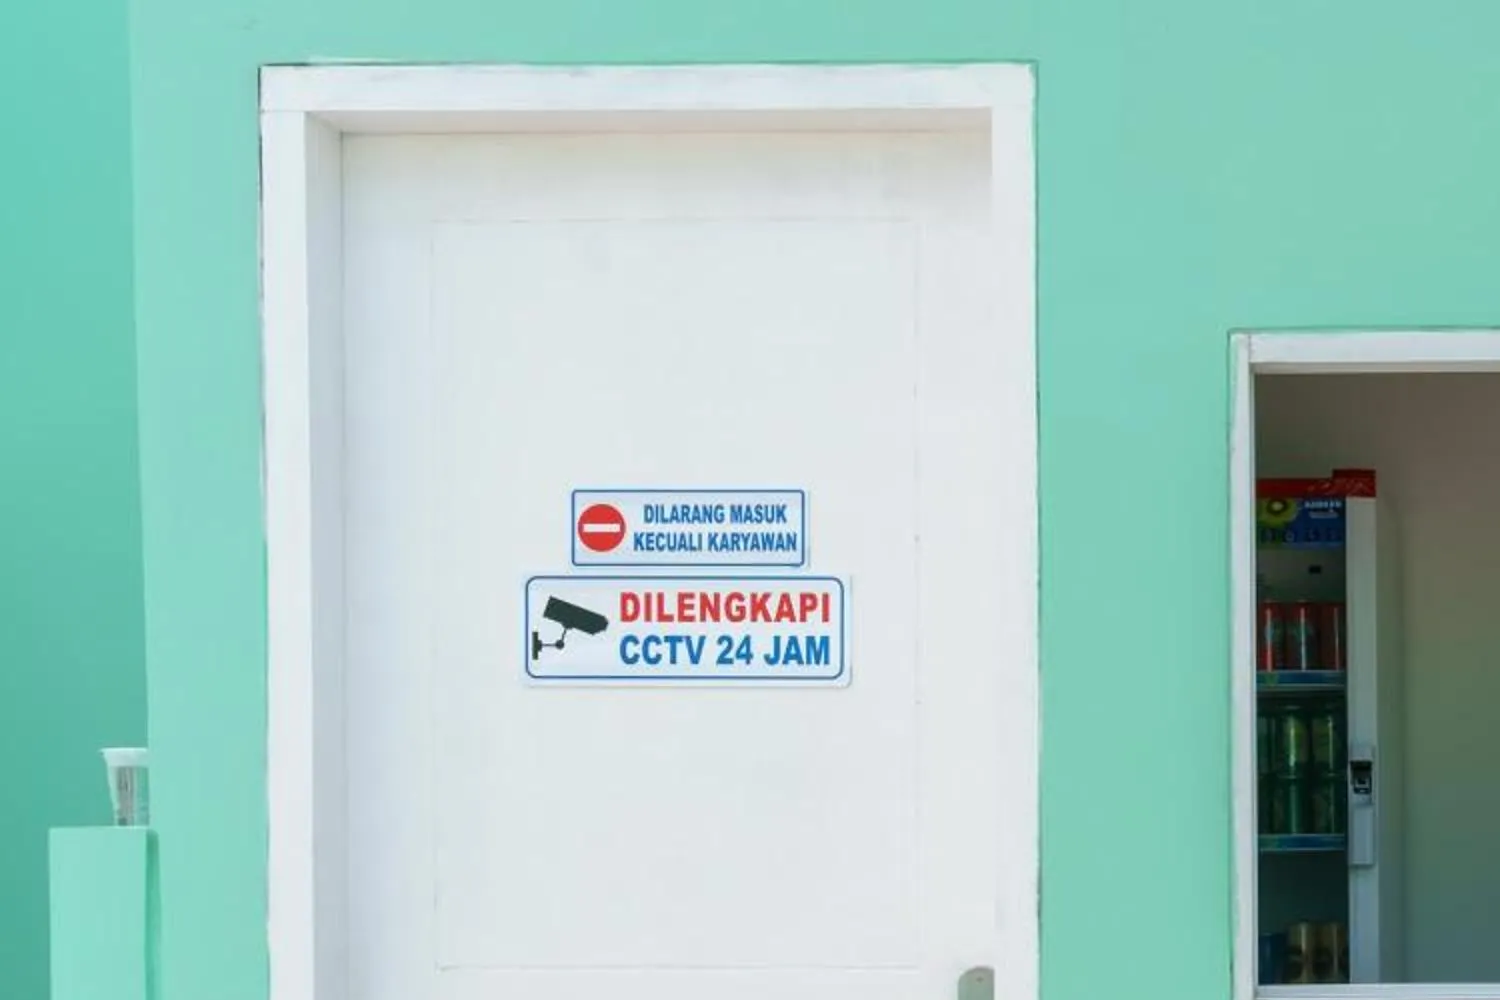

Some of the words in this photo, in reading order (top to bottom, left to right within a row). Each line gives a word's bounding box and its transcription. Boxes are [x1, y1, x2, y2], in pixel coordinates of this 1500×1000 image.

[643, 504, 726, 524] DILARANG
[730, 504, 787, 524] MASUK
[633, 532, 703, 552] KECUALI
[708, 532, 797, 552] KARYAWAN
[620, 592, 831, 623] DILENGKAPI
[620, 634, 706, 666] CCTV
[716, 634, 754, 666] 24
[764, 635, 831, 666] JAM
